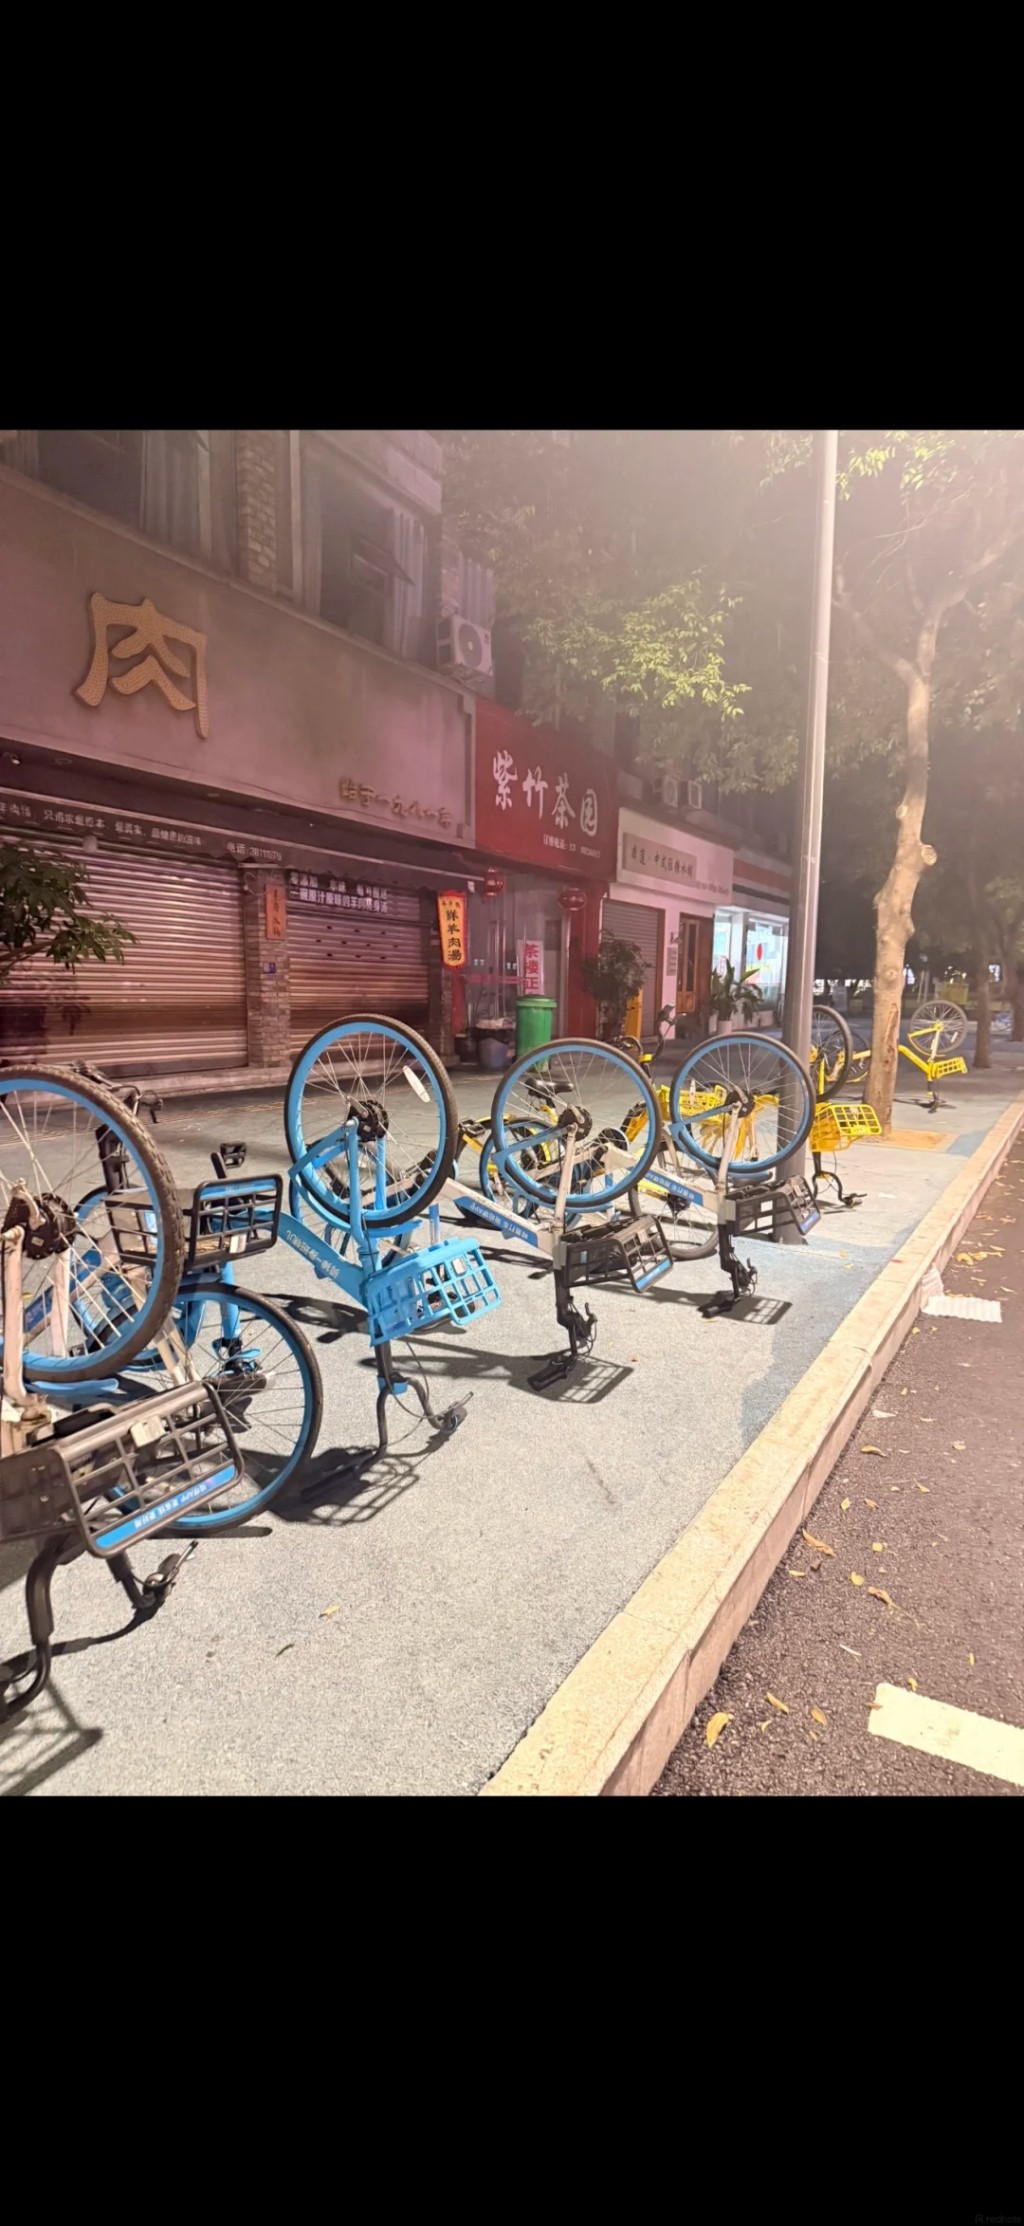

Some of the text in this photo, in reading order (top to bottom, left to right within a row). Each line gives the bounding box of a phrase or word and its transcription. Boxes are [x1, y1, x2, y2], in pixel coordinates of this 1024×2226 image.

[73, 591, 209, 740] 肉
[492, 749, 599, 838] 紫竹茶园
[524, 942, 539, 991] 茶楼正
